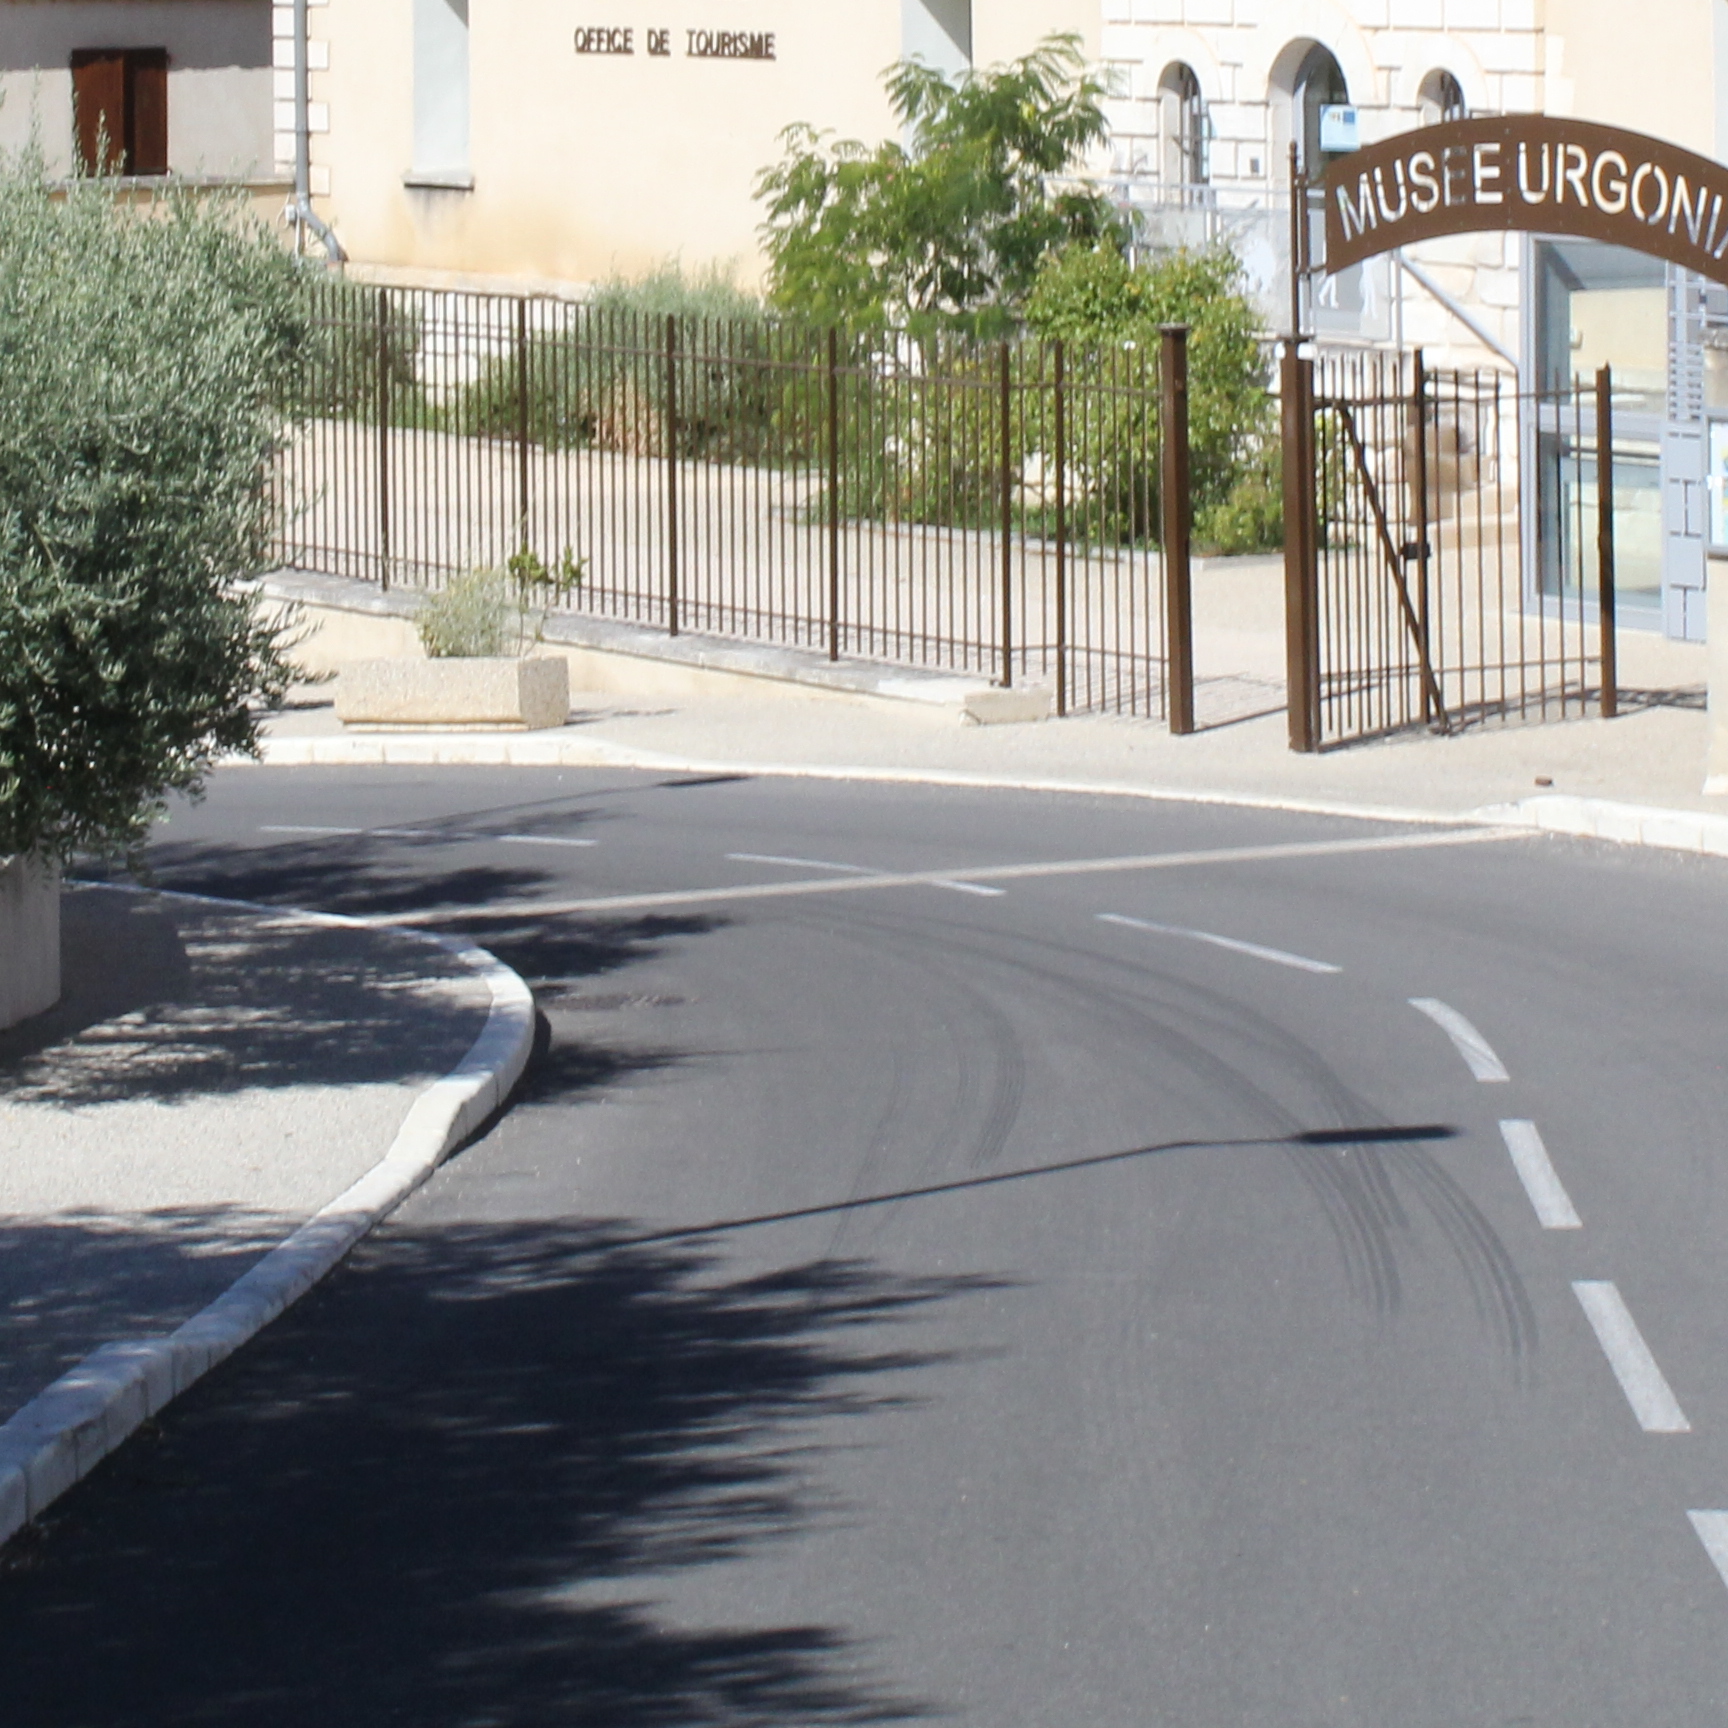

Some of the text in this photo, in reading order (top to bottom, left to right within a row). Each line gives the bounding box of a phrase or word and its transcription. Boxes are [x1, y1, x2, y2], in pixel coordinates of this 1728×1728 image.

[574, 26, 776, 61] OFFICE DE TOURISME
[1336, 141, 1503, 242] MUSEE
